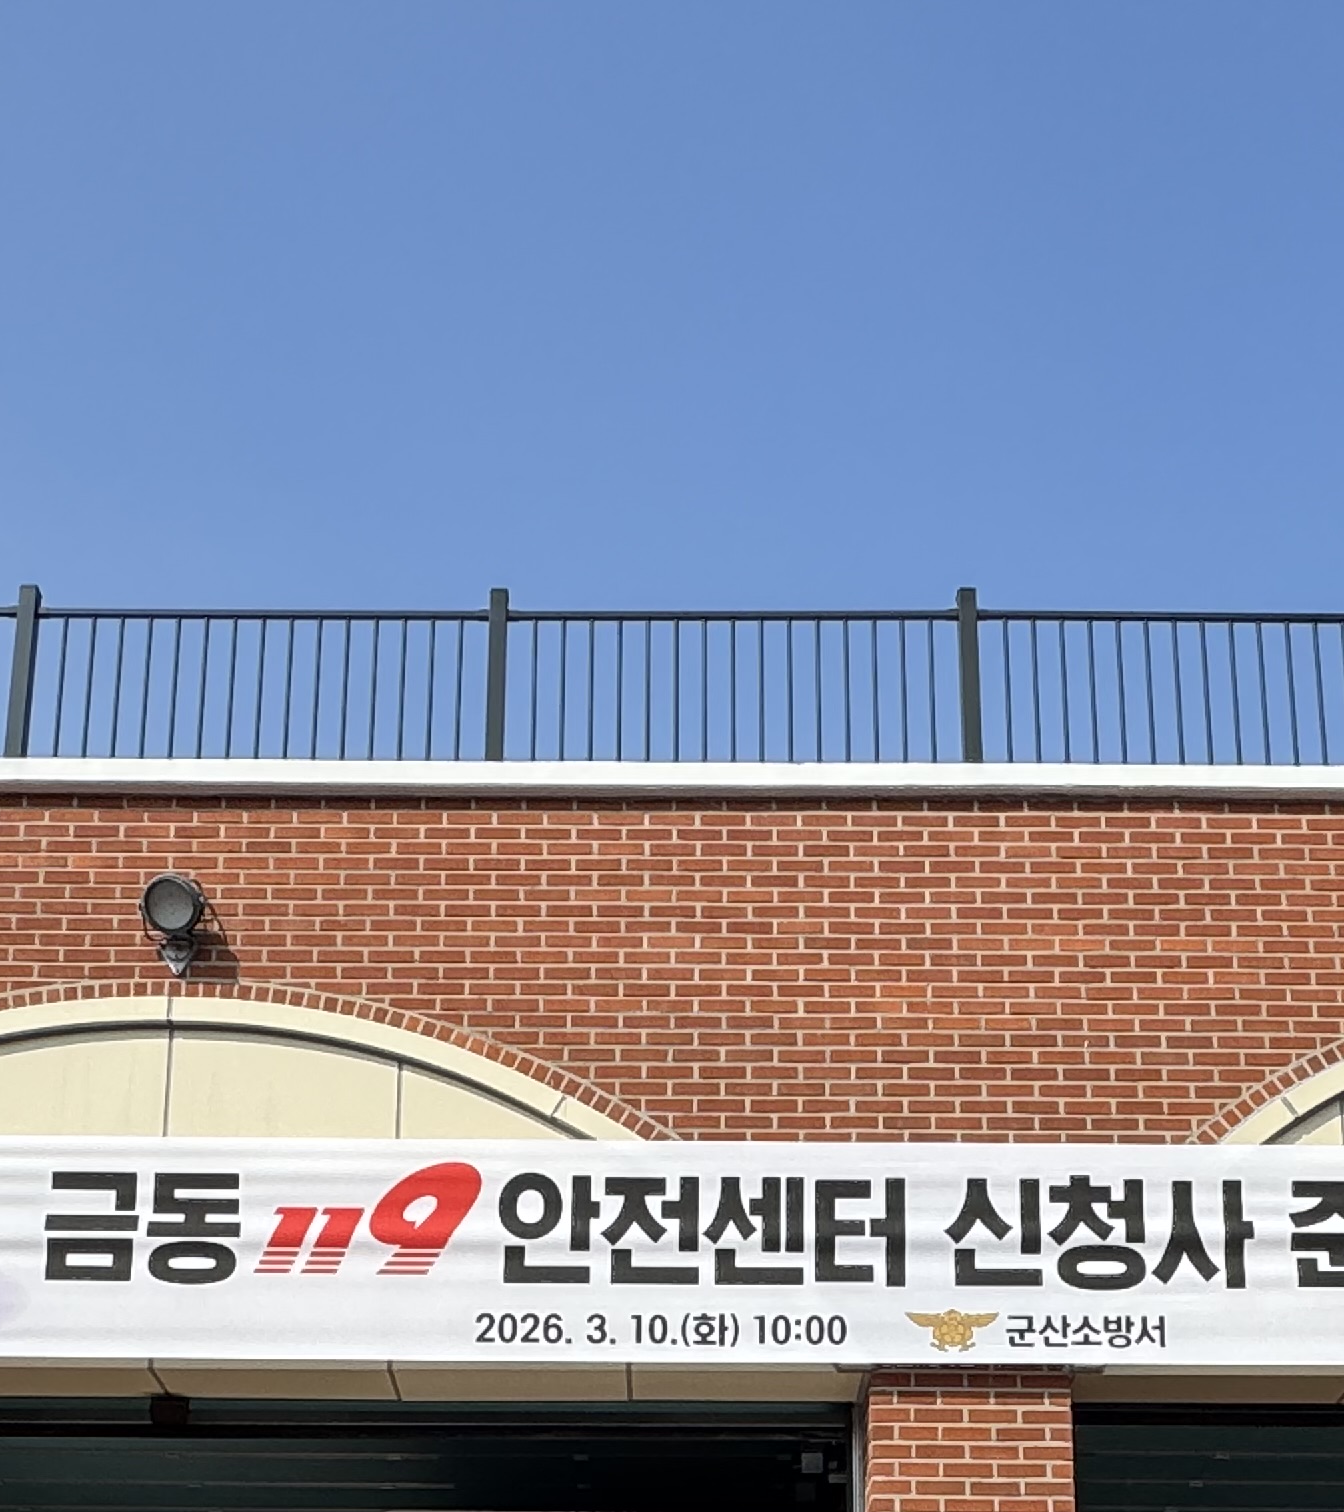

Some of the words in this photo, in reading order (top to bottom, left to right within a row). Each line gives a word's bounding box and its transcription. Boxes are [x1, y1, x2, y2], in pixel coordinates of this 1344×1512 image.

[944, 1174, 1253, 1290] 신청사
[475, 1313, 573, 1345] 2026.
[585, 1314, 616, 1345] 3.
[753, 1313, 848, 1346] 10:00
[1005, 1312, 1167, 1349] 군산소방서
